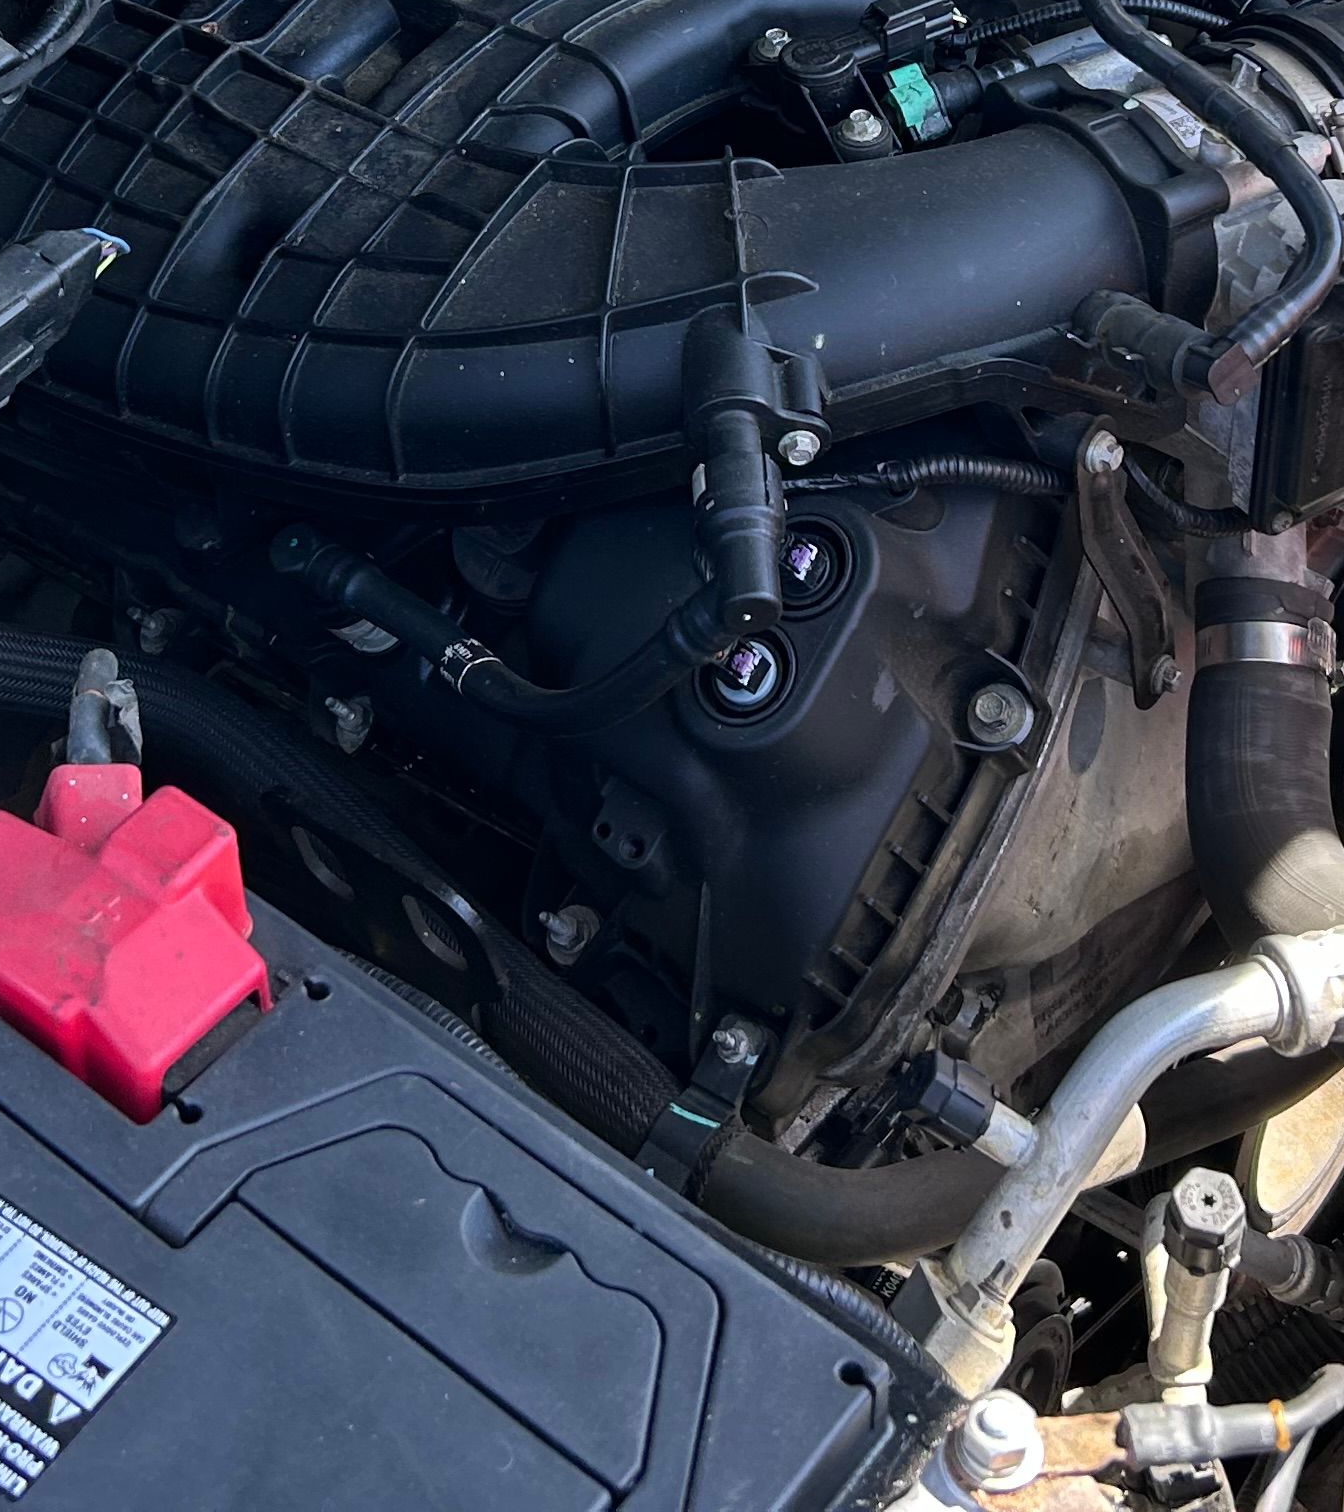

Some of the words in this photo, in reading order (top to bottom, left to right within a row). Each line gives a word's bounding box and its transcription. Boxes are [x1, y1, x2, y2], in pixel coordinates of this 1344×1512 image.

[20, 1269, 52, 1294] SPARKS
[28, 1261, 60, 1285] FLAMES
[13, 1284, 37, 1304] NO
[51, 1319, 88, 1349] SHIELD
[64, 1313, 92, 1336] EYES
